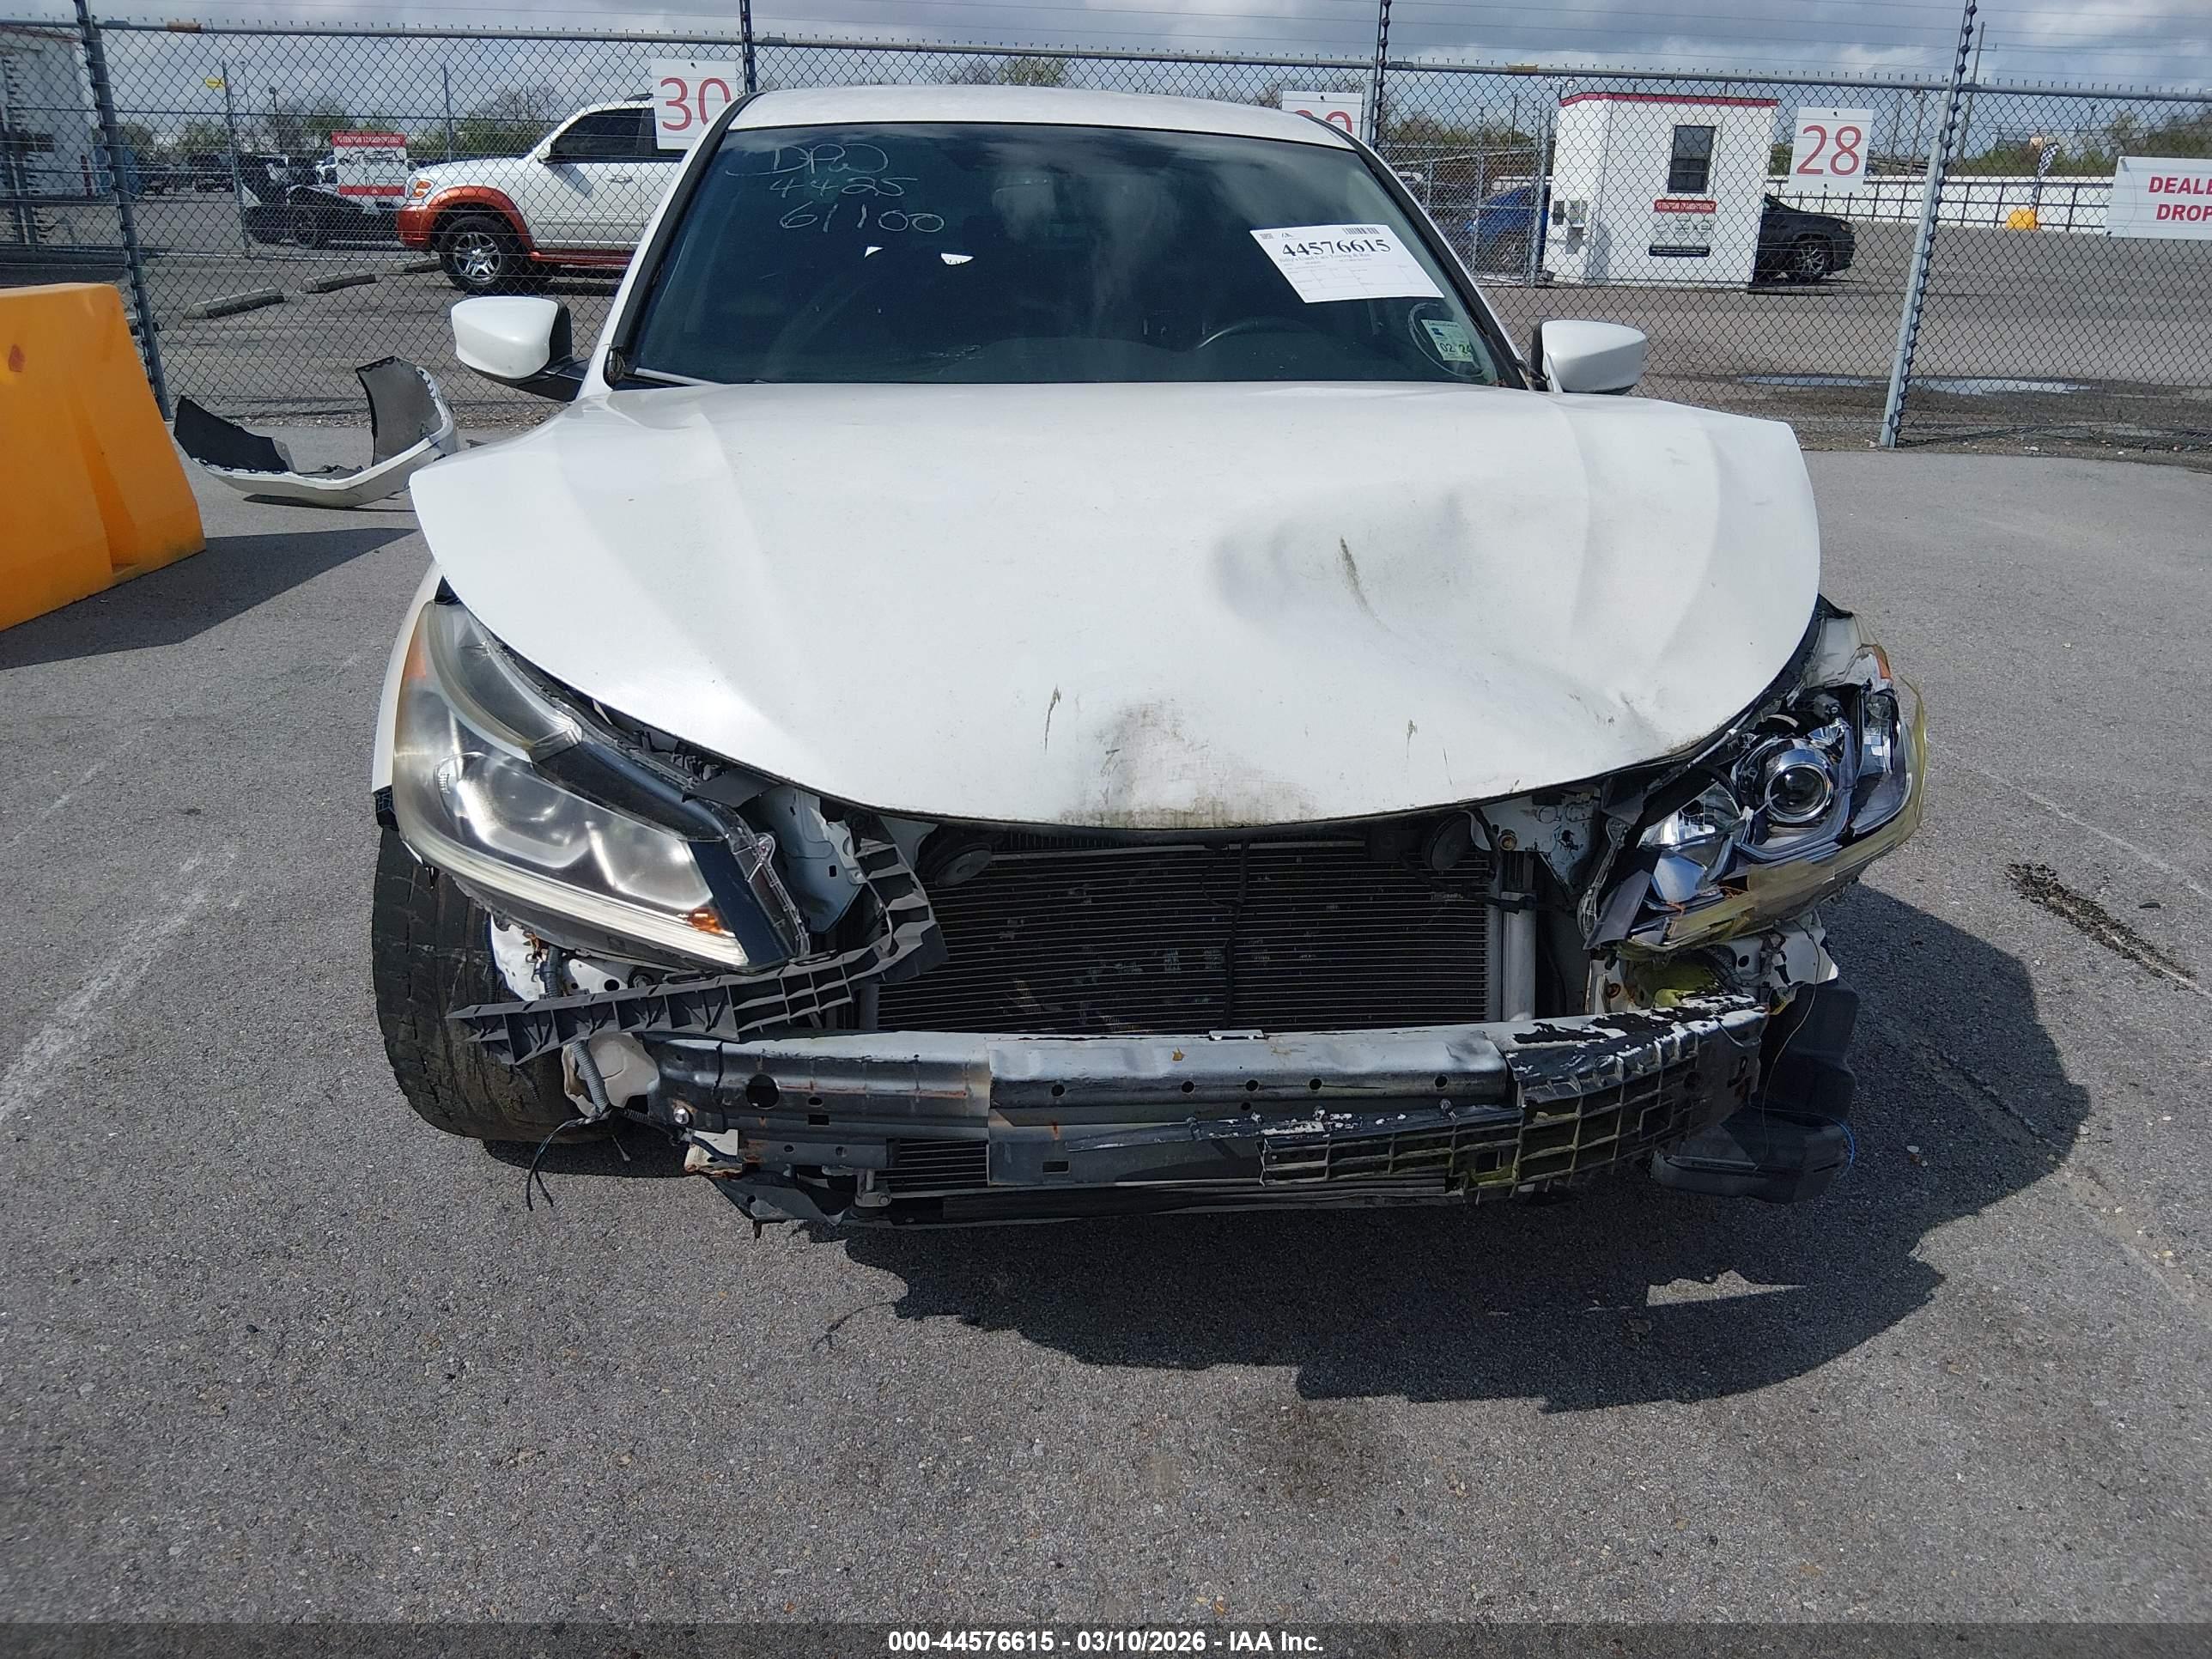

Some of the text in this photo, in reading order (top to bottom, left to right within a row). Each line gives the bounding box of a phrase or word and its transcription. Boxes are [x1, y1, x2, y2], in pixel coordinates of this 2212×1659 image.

[660, 77, 732, 131] 30
[1796, 125, 1862, 175] 28
[769, 177, 918, 198] 4425
[780, 201, 945, 233] 61100
[2156, 204, 2212, 221] DROP
[1282, 240, 1391, 257] 44576615
[1440, 343, 1456, 352] 02
